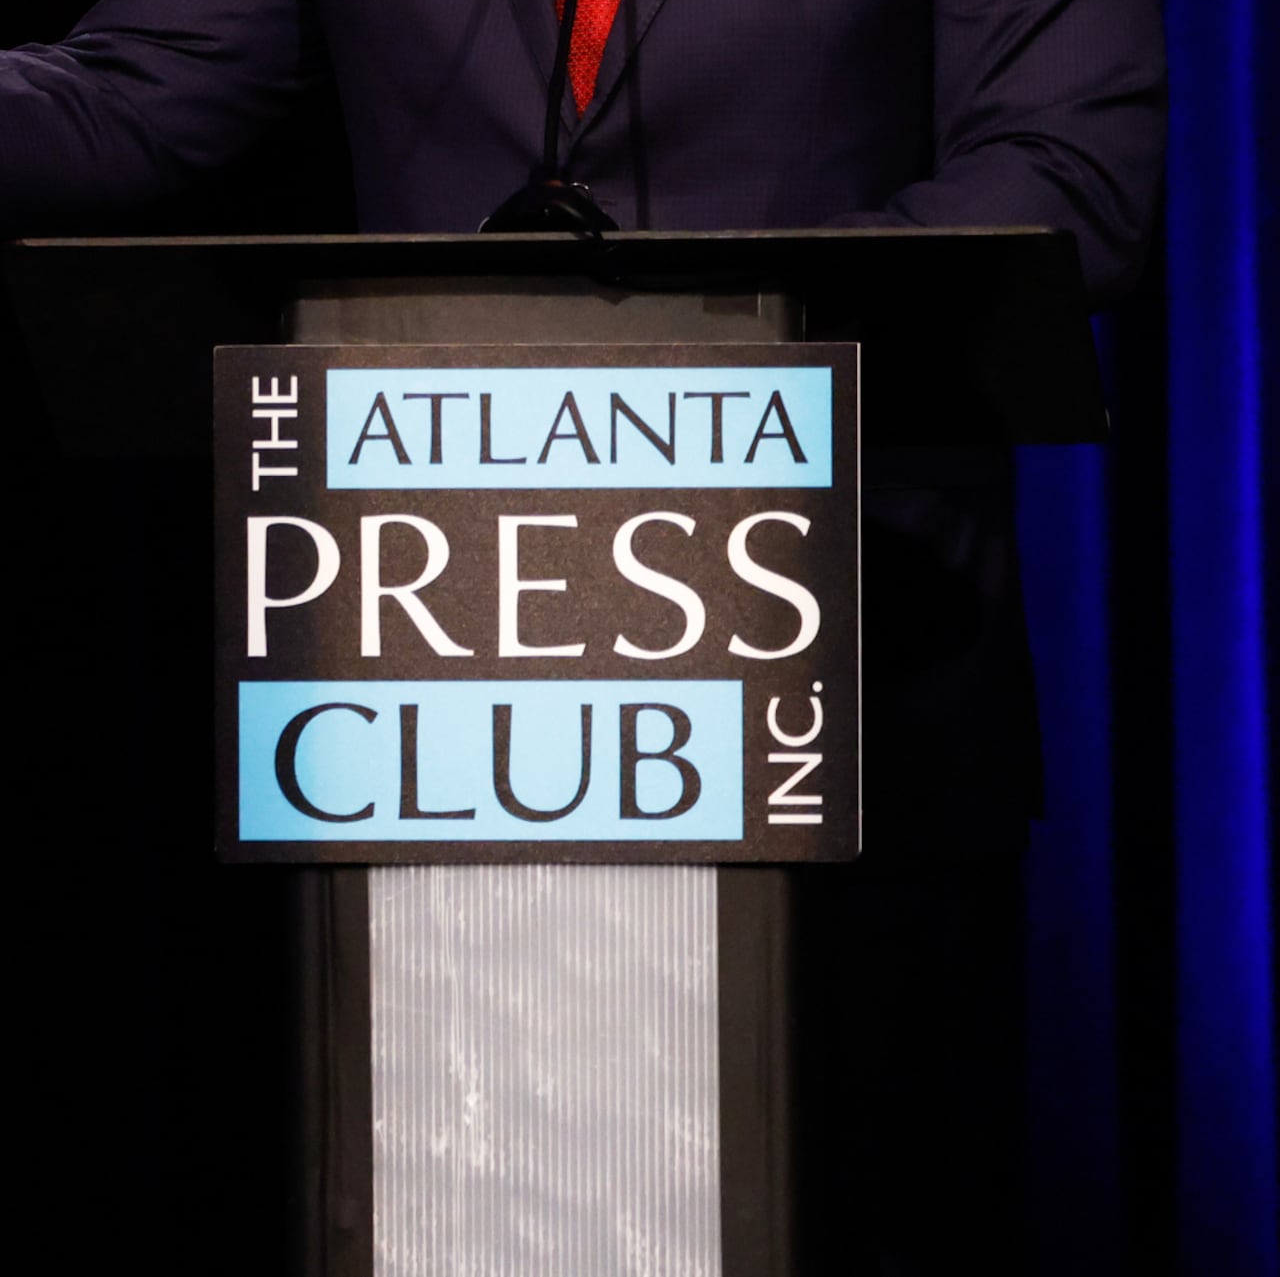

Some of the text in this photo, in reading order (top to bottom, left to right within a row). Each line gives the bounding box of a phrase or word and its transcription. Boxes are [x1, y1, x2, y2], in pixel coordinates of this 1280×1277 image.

[253, 376, 297, 491] THE
[349, 390, 808, 465] ATLANTA
[248, 511, 820, 660] PRESS
[274, 703, 701, 823] CLUB
[767, 682, 822, 824] INC.
